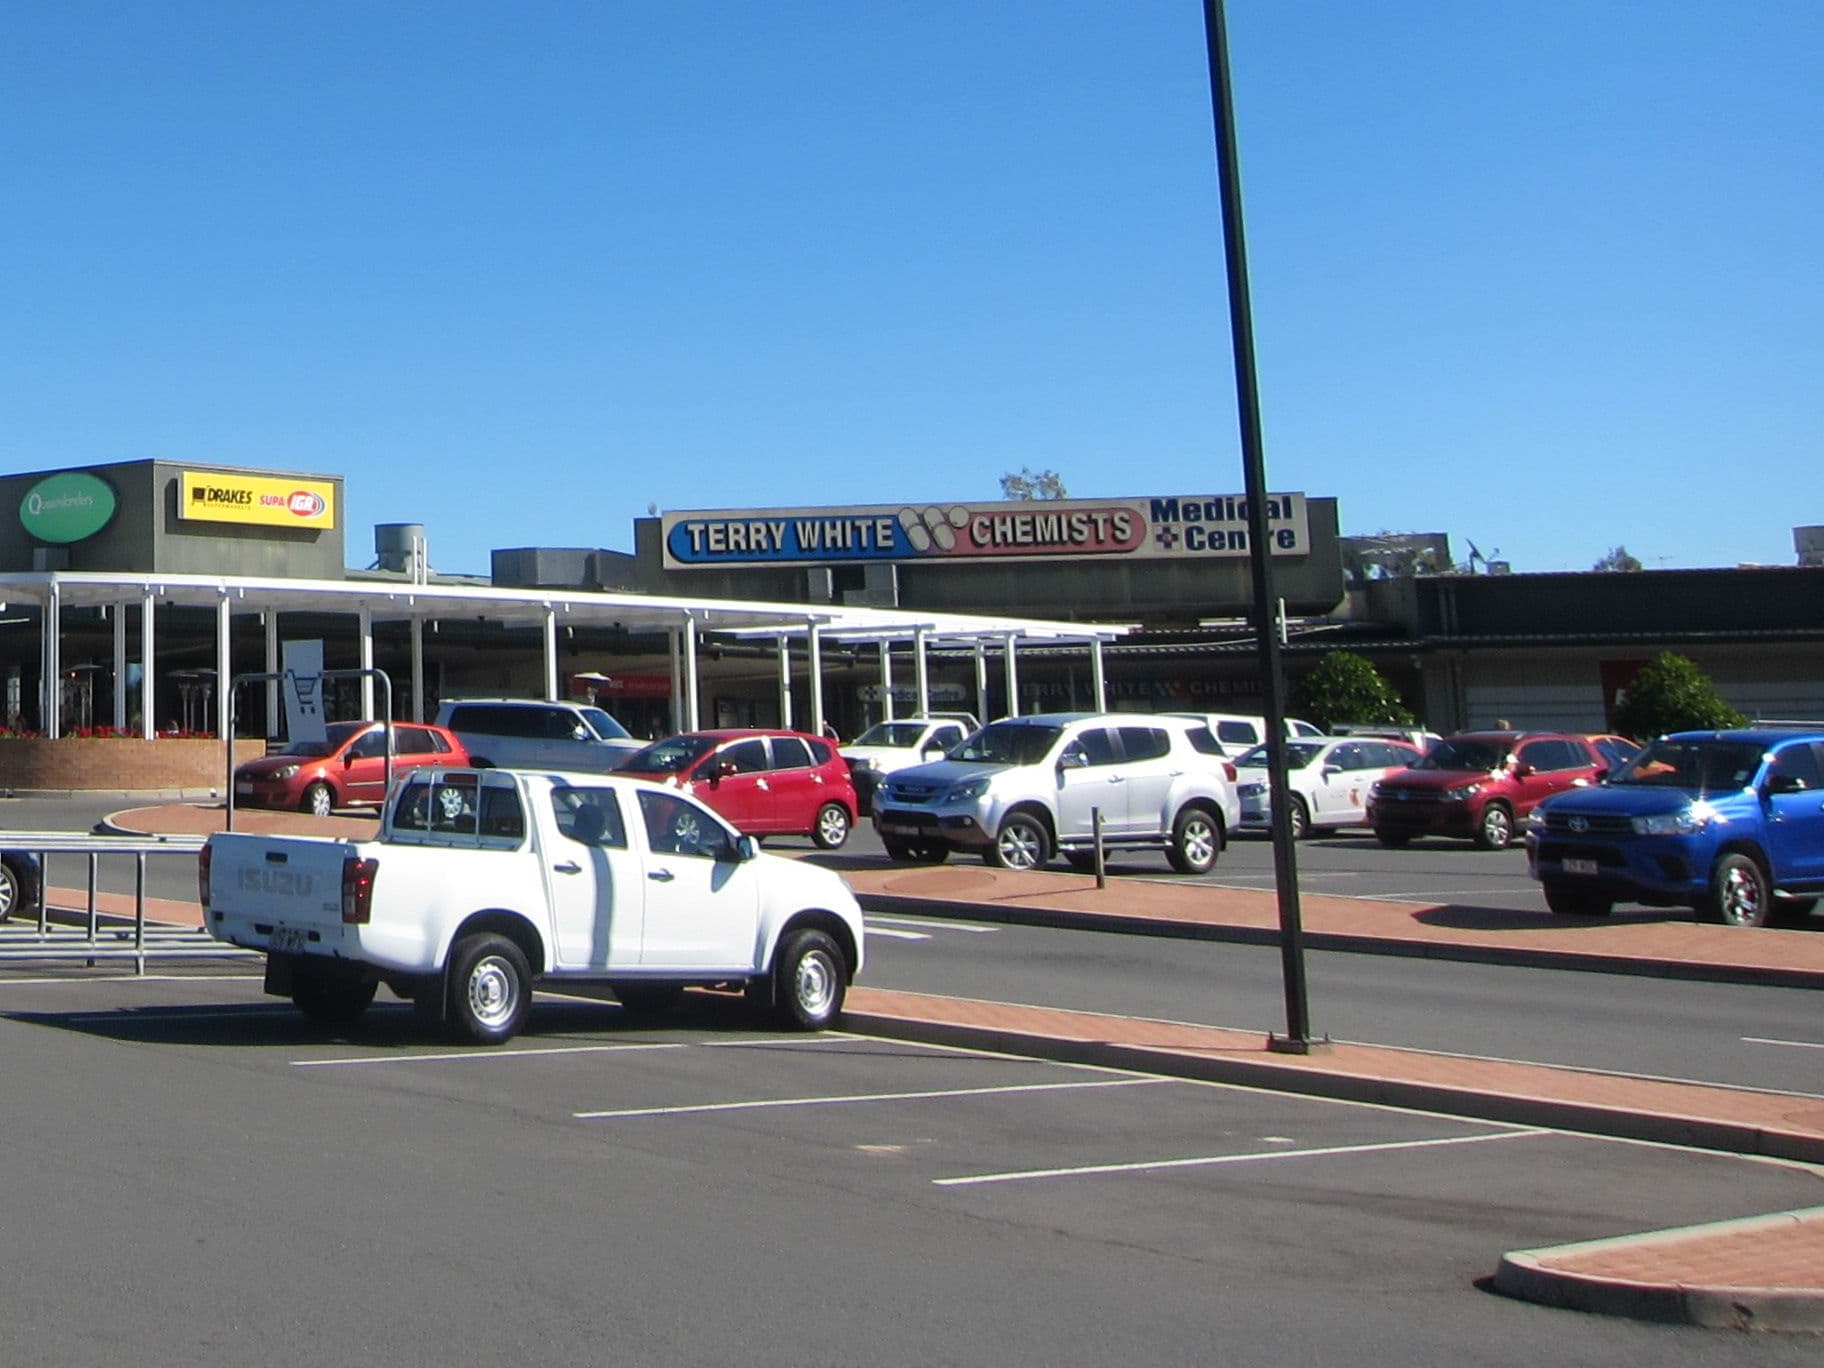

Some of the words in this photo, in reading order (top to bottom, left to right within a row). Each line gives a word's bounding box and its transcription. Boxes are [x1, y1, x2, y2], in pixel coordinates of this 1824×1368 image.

[207, 488, 253, 504] DRAKES
[260, 495, 285, 506] SUPA
[291, 494, 316, 512] IGA
[687, 521, 785, 551] TERRY
[796, 519, 894, 549] WHITE
[971, 511, 1131, 545] CHEMISTS
[1185, 526, 1296, 551] Cene
[238, 868, 312, 897] ISUZU
